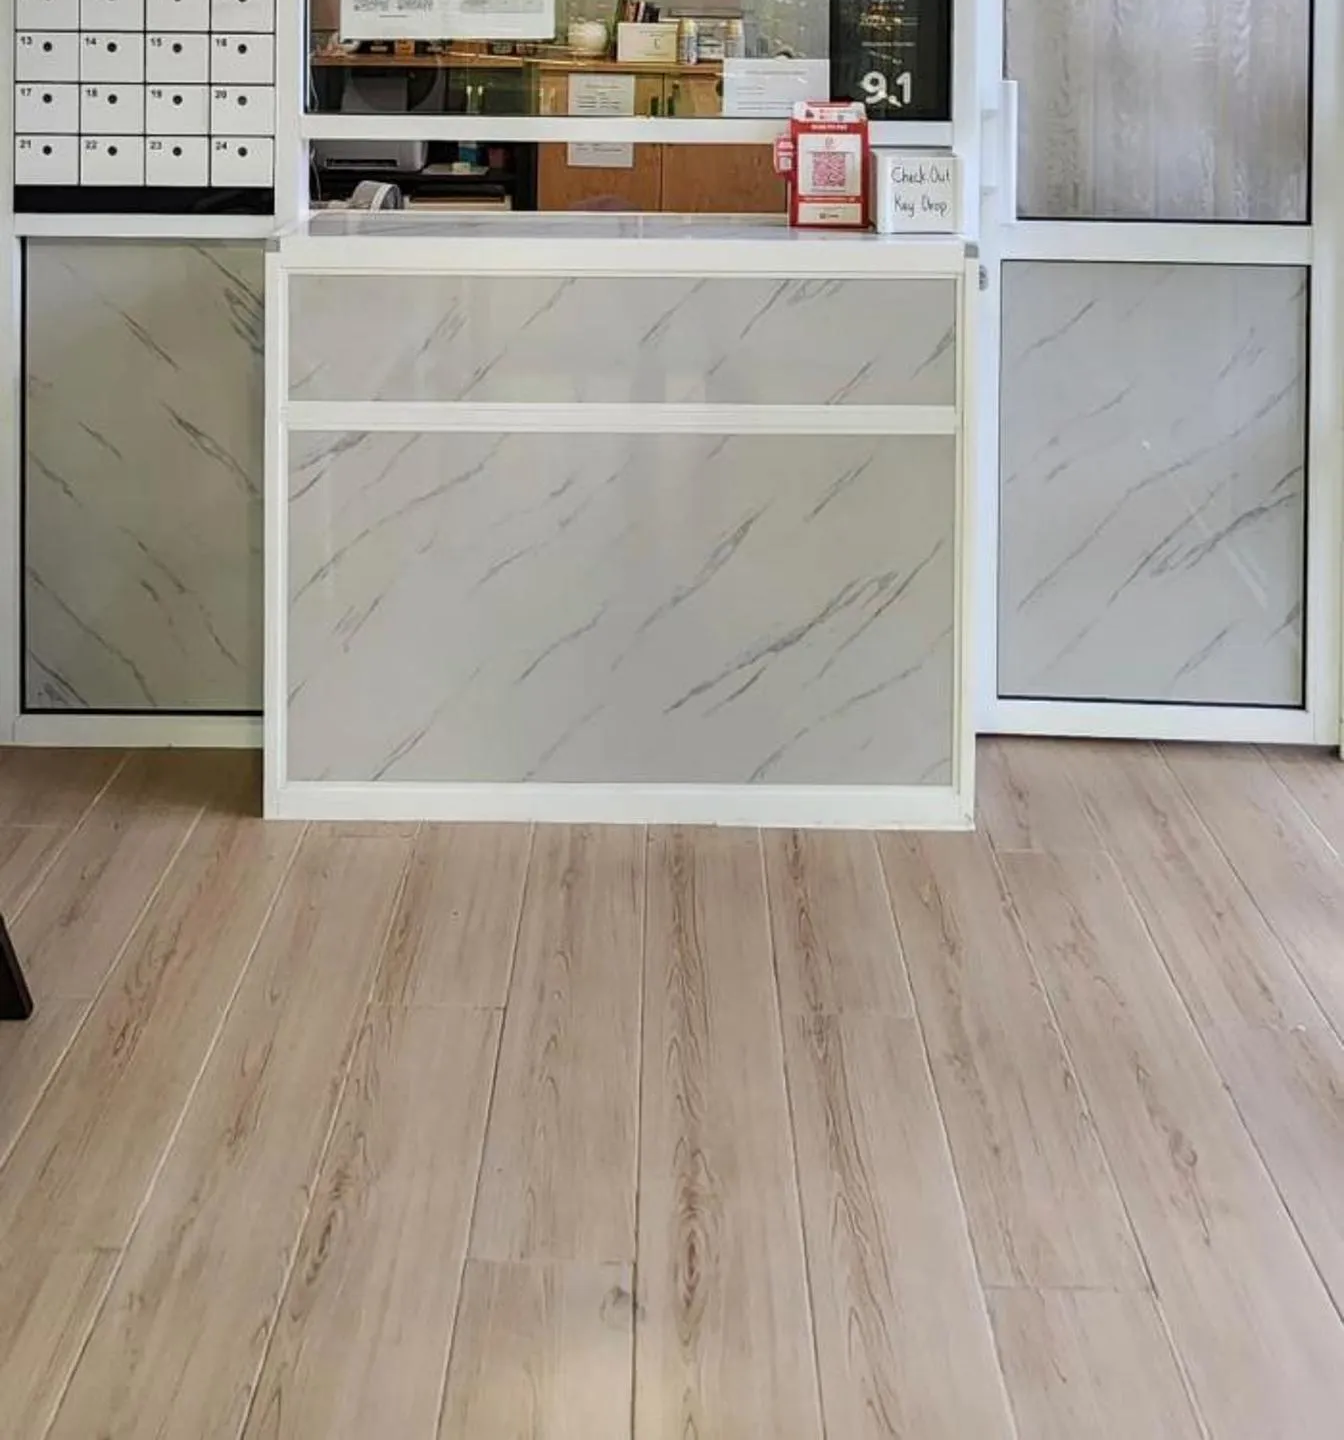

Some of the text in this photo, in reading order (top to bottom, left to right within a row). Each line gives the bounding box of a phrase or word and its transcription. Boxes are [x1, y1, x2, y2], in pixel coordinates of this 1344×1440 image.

[19, 35, 33, 46] 13
[84, 36, 97, 46] 14
[150, 37, 163, 48] 15
[20, 87, 33, 97] 17
[19, 139, 32, 150] 21
[84, 139, 98, 151] 22
[149, 140, 163, 151] 23
[215, 141, 228, 151] 24
[890, 164, 950, 184] Check Out
[893, 192, 948, 218] Key Drop
